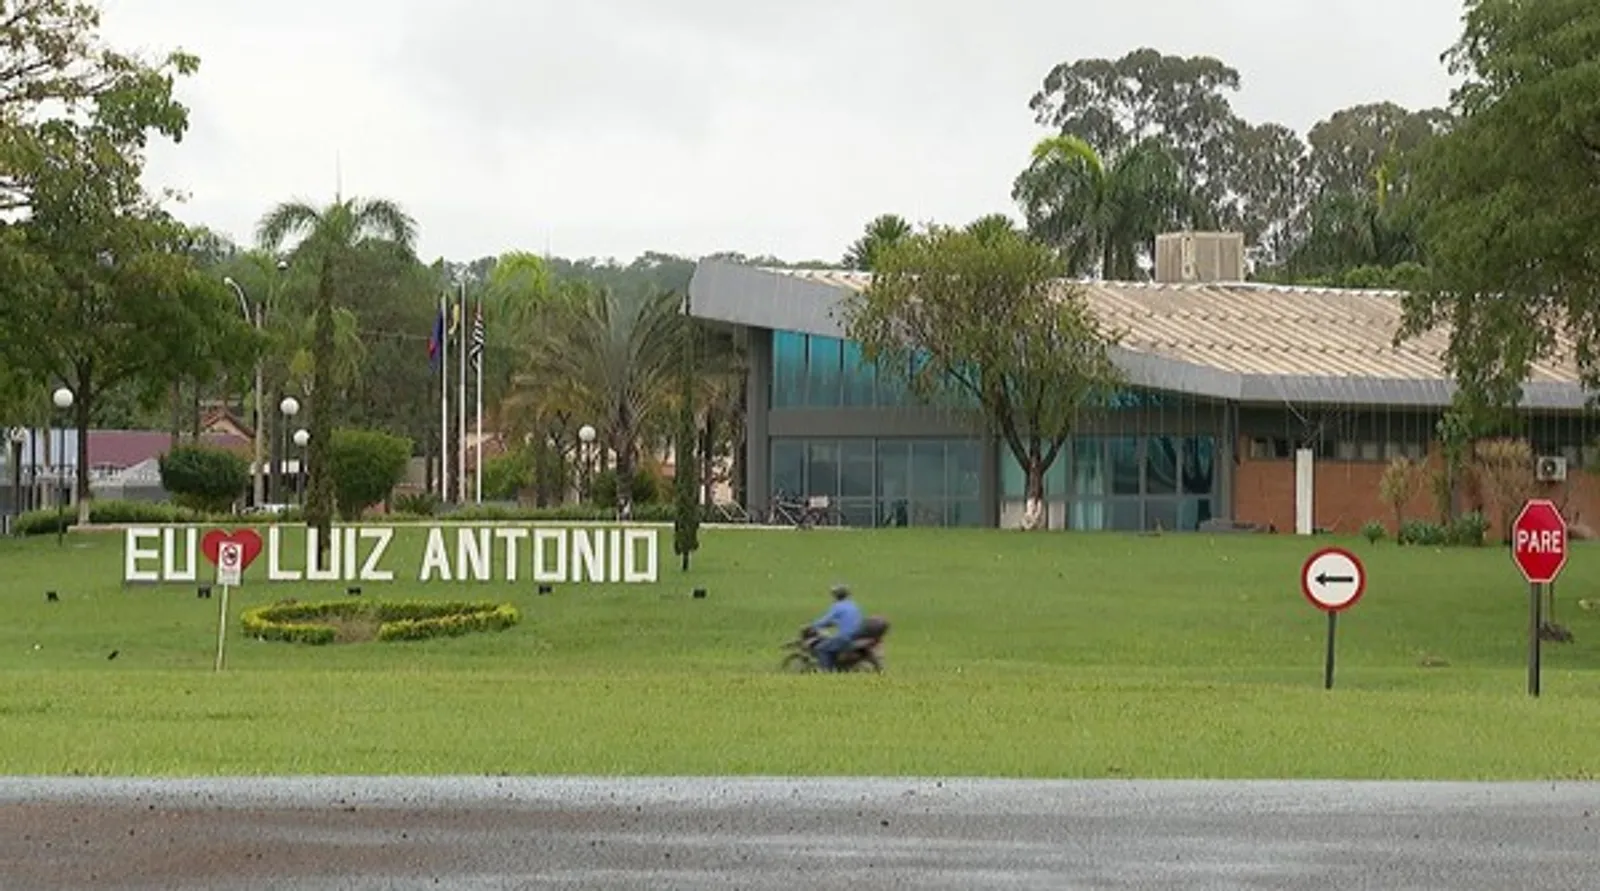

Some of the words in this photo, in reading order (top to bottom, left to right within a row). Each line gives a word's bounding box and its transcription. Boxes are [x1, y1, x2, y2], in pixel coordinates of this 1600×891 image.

[126, 527, 197, 580] EU
[268, 527, 394, 580] LUIZ
[420, 527, 657, 582] ANTONIO
[1517, 530, 1561, 553] PARE
